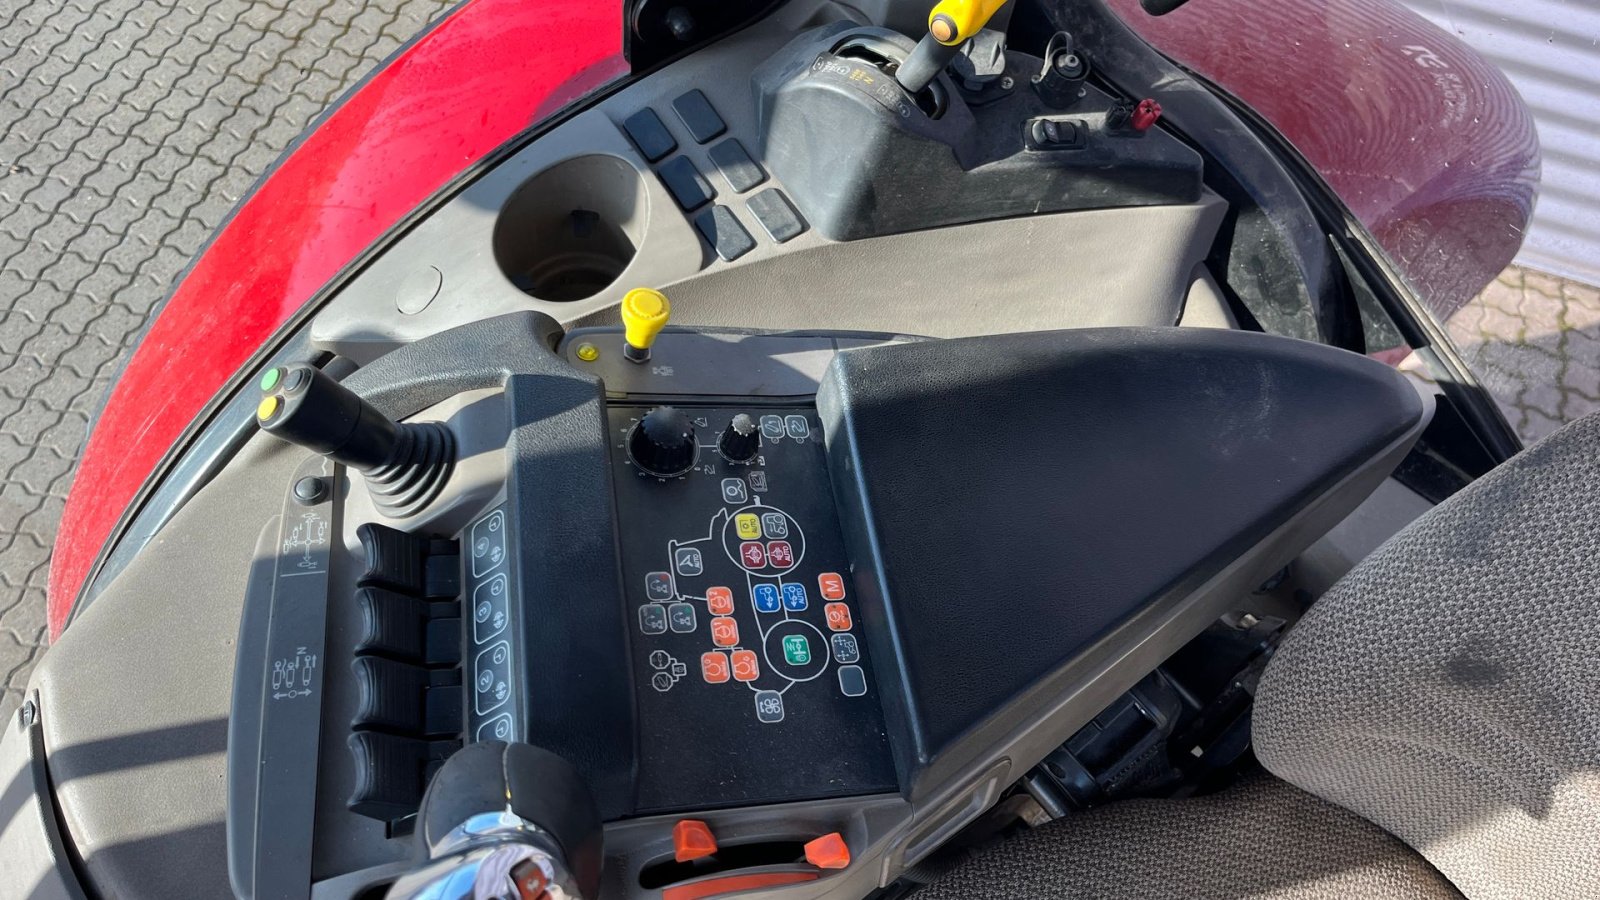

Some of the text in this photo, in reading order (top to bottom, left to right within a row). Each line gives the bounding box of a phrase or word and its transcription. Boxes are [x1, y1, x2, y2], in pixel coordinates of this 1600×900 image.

[750, 518, 758, 534] AUTO
[693, 553, 701, 569] AUTO
[782, 545, 791, 562] AUTO
[827, 580, 840, 592] M
[797, 587, 805, 604] AUTO
[297, 646, 307, 655] N
